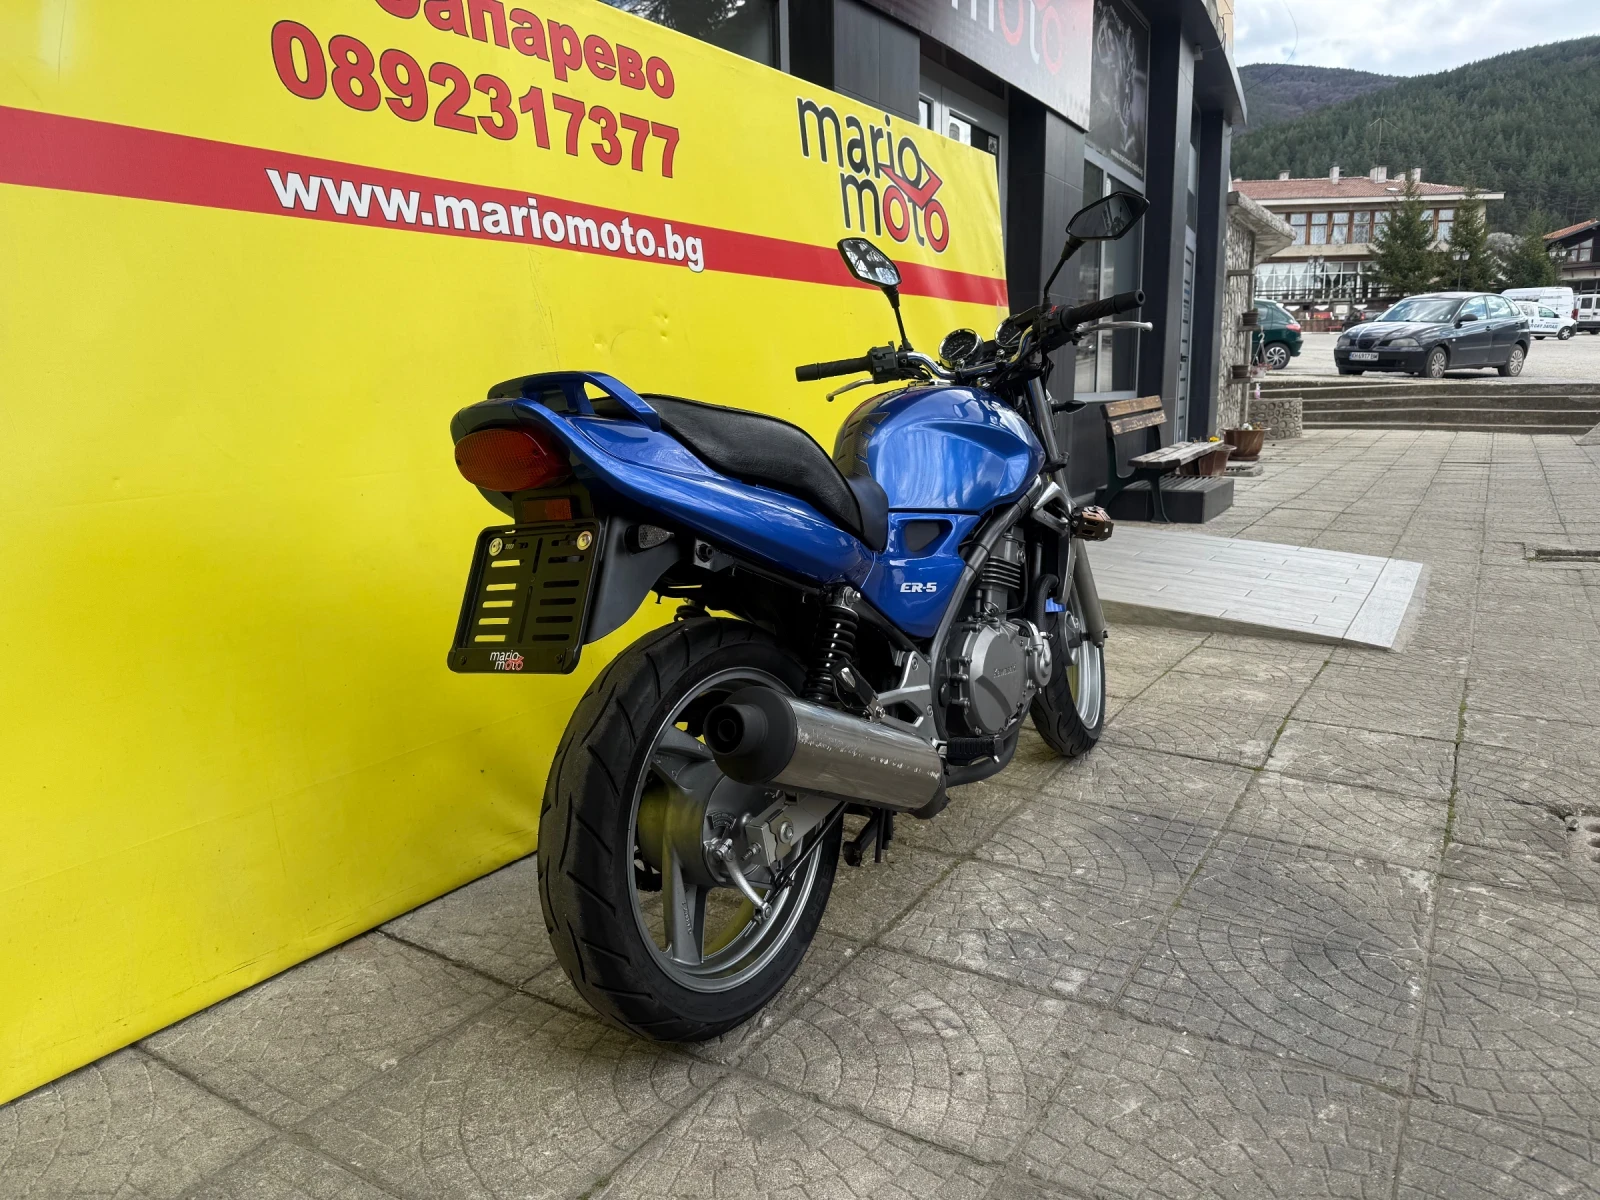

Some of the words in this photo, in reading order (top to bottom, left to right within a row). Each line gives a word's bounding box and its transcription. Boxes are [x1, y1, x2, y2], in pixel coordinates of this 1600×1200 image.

[374, 0, 675, 99] апарево
[271, 19, 680, 179] 0892317377
[796, 96, 925, 187] mario
[265, 167, 704, 272] www.mariomoto.bg
[839, 170, 950, 253] moto
[899, 582, 937, 593] ER-5
[489, 649, 520, 661] mario
